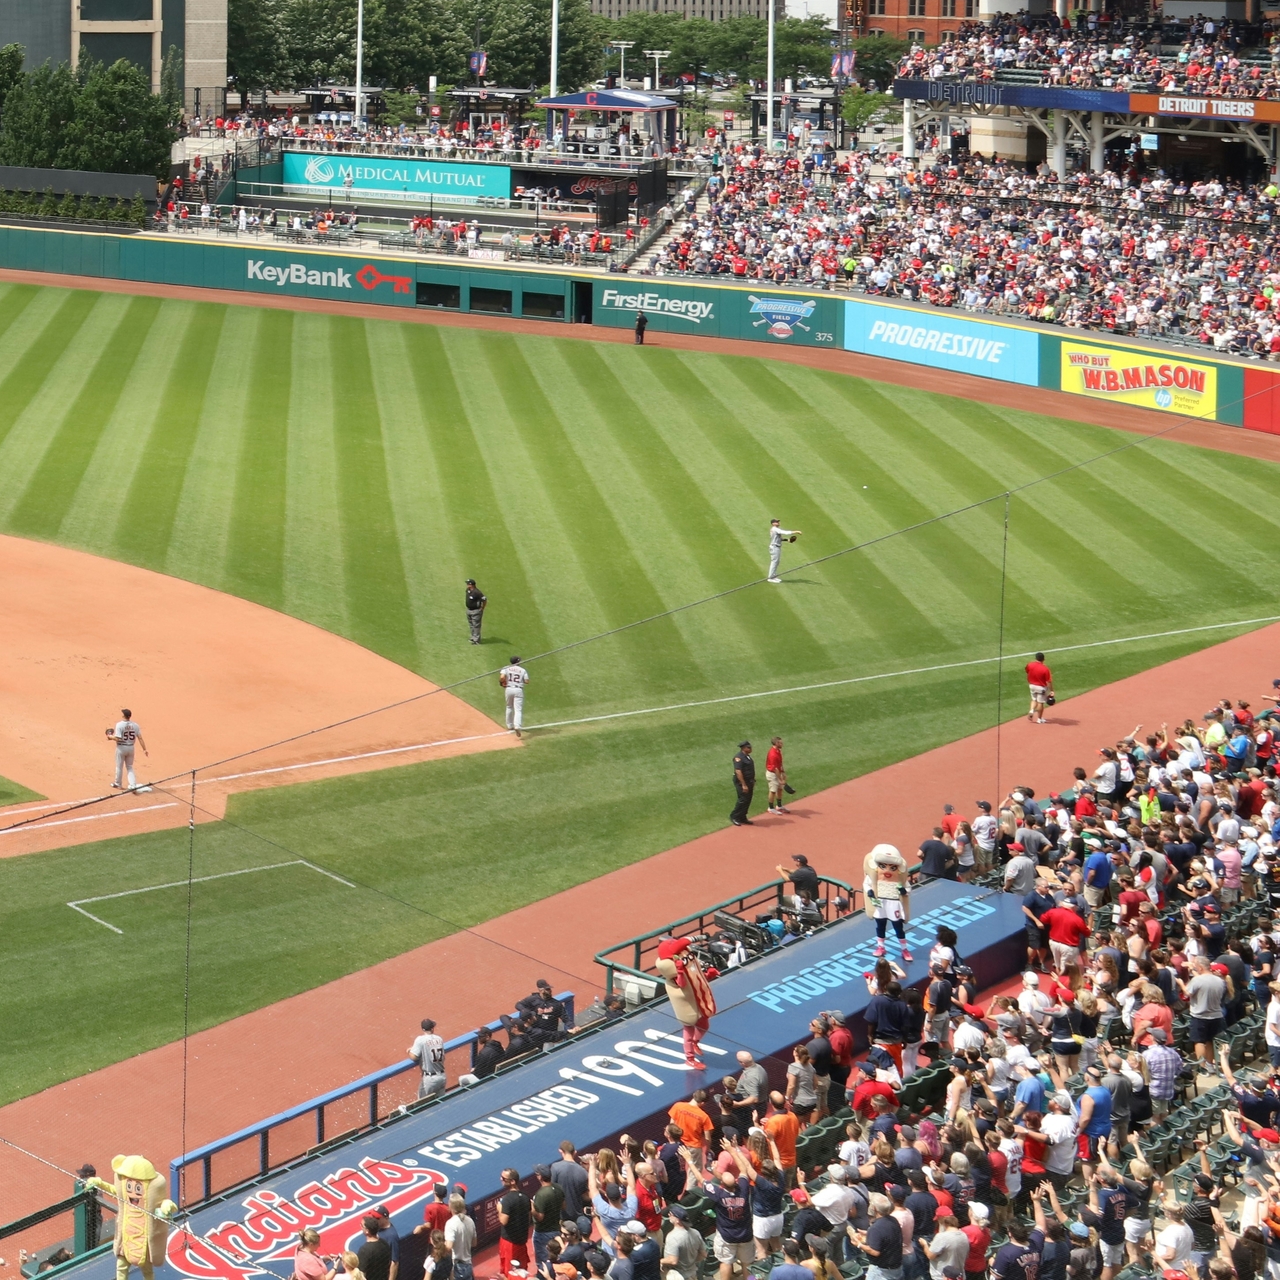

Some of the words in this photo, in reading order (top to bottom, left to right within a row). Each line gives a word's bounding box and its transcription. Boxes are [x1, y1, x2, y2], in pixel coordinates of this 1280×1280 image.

[928, 81, 1004, 104] DETROIT
[1159, 97, 1208, 113] DETROIT
[1210, 100, 1254, 116] TIGERS
[338, 164, 410, 182] MEDICAL
[415, 168, 484, 187] MUTUAL
[247, 260, 351, 289] KeyBank
[602, 289, 714, 319] FirstEnergy
[756, 303, 808, 314] PROGRESSIVE
[815, 332, 833, 341] 375
[868, 321, 1008, 363] PROGRESSIVE
[1069, 354, 1089, 365] WHO
[1091, 356, 1110, 366] BUT
[1083, 364, 1207, 393] W.B.MASON
[1156, 390, 1170, 408] hp
[1174, 394, 1200, 405] Preferred
[1174, 401, 1195, 410] Partner
[508, 673, 521, 683] 12
[123, 731, 136, 741] 55
[430, 1048, 443, 1063] 17
[559, 1028, 728, 1097] 1901
[418, 1084, 600, 1168] ESTABLISHED
